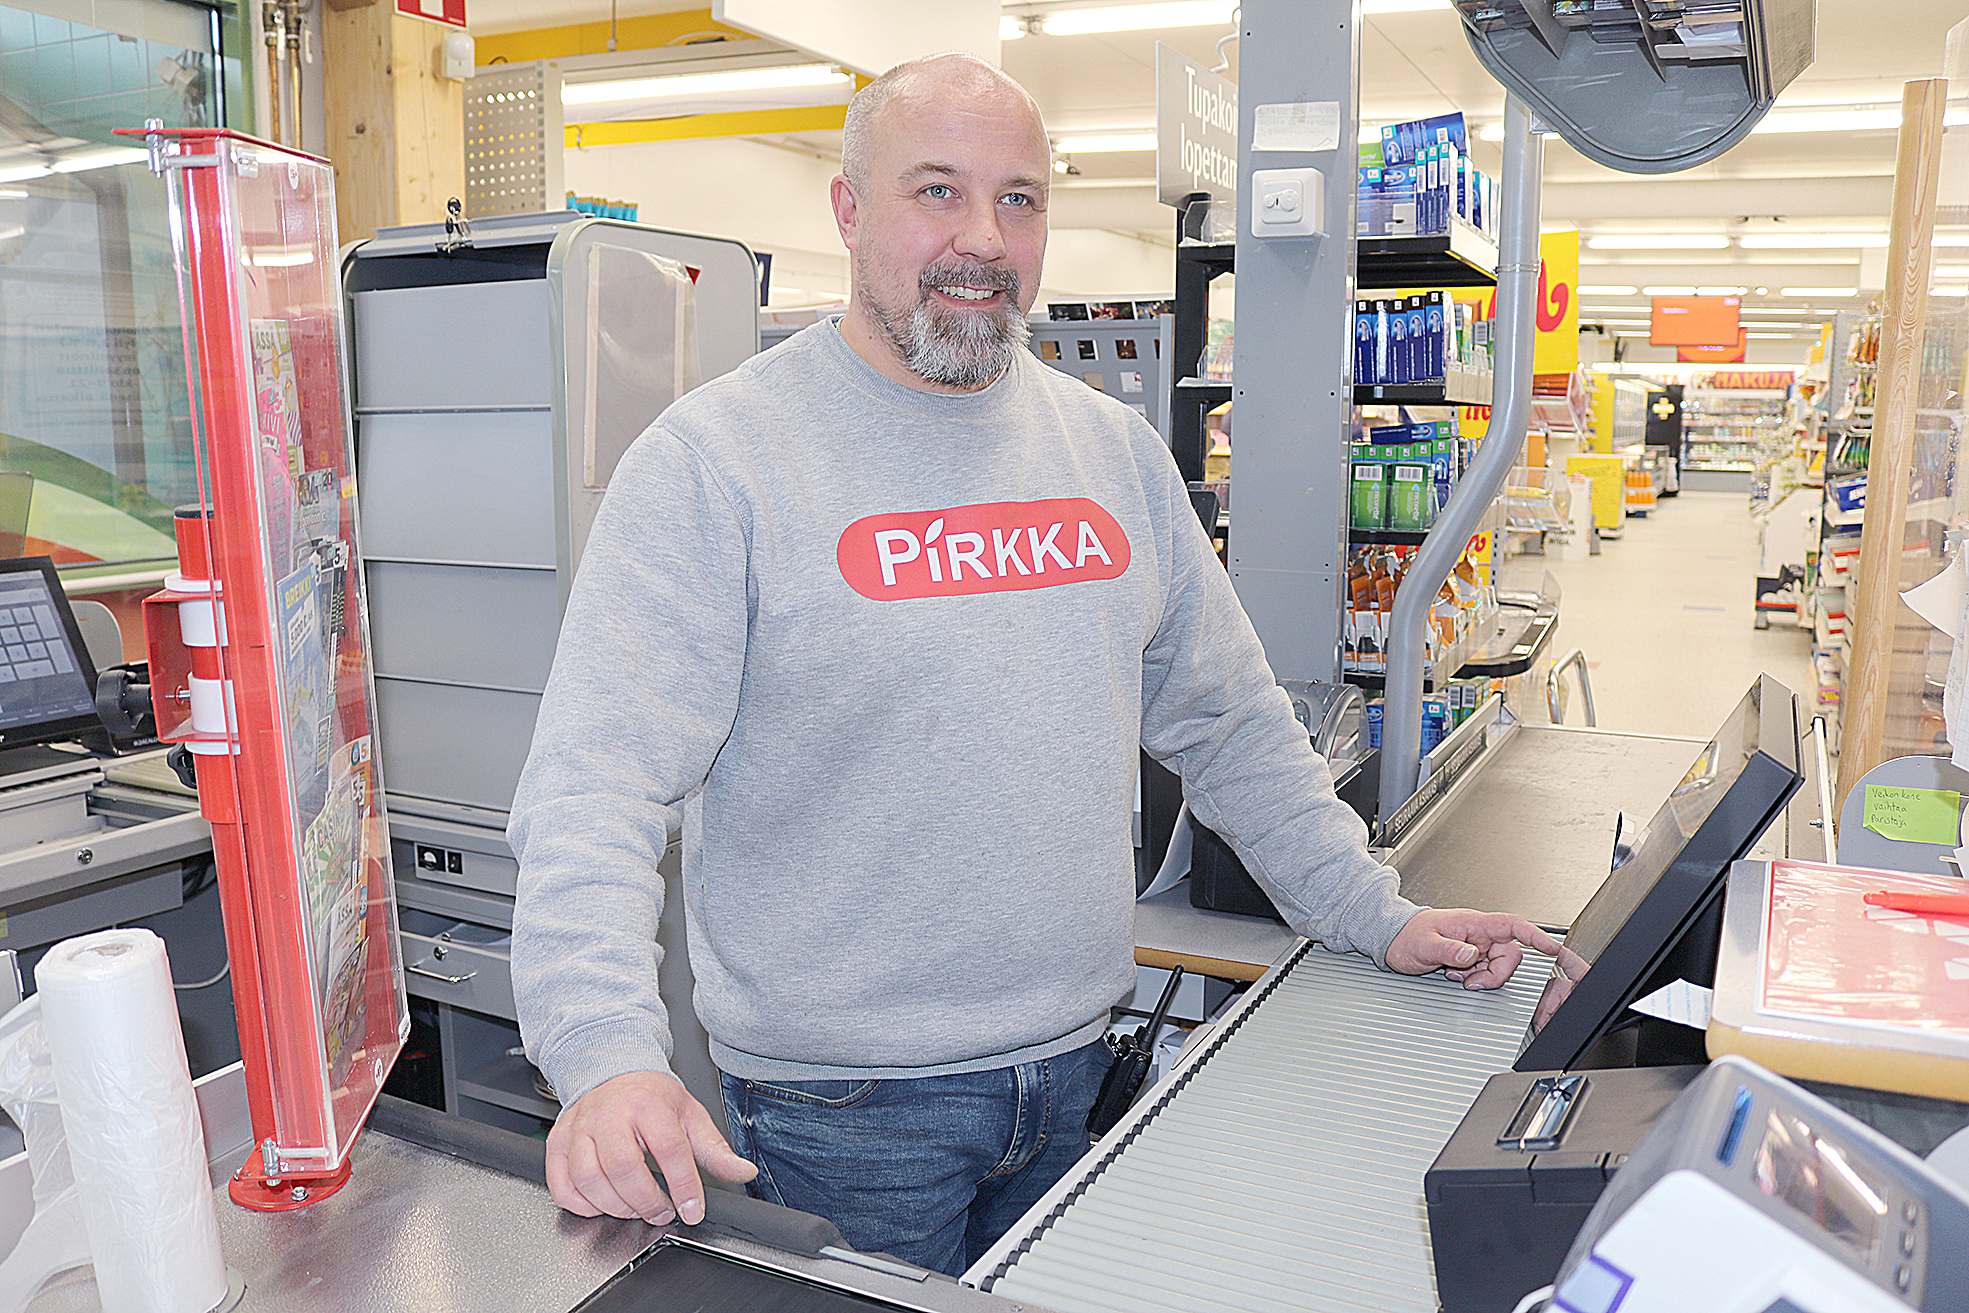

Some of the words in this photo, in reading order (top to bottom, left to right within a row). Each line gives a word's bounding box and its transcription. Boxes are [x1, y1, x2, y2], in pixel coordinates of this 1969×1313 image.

[285, 574, 312, 610] BREIKKI
[1394, 797, 1420, 833] SEURAAVA
[1419, 780, 1438, 807] ASIAKAS
[1872, 788, 1900, 798] Veikon
[1902, 789, 1921, 801] kone
[1874, 801, 1907, 813] vaihtaa
